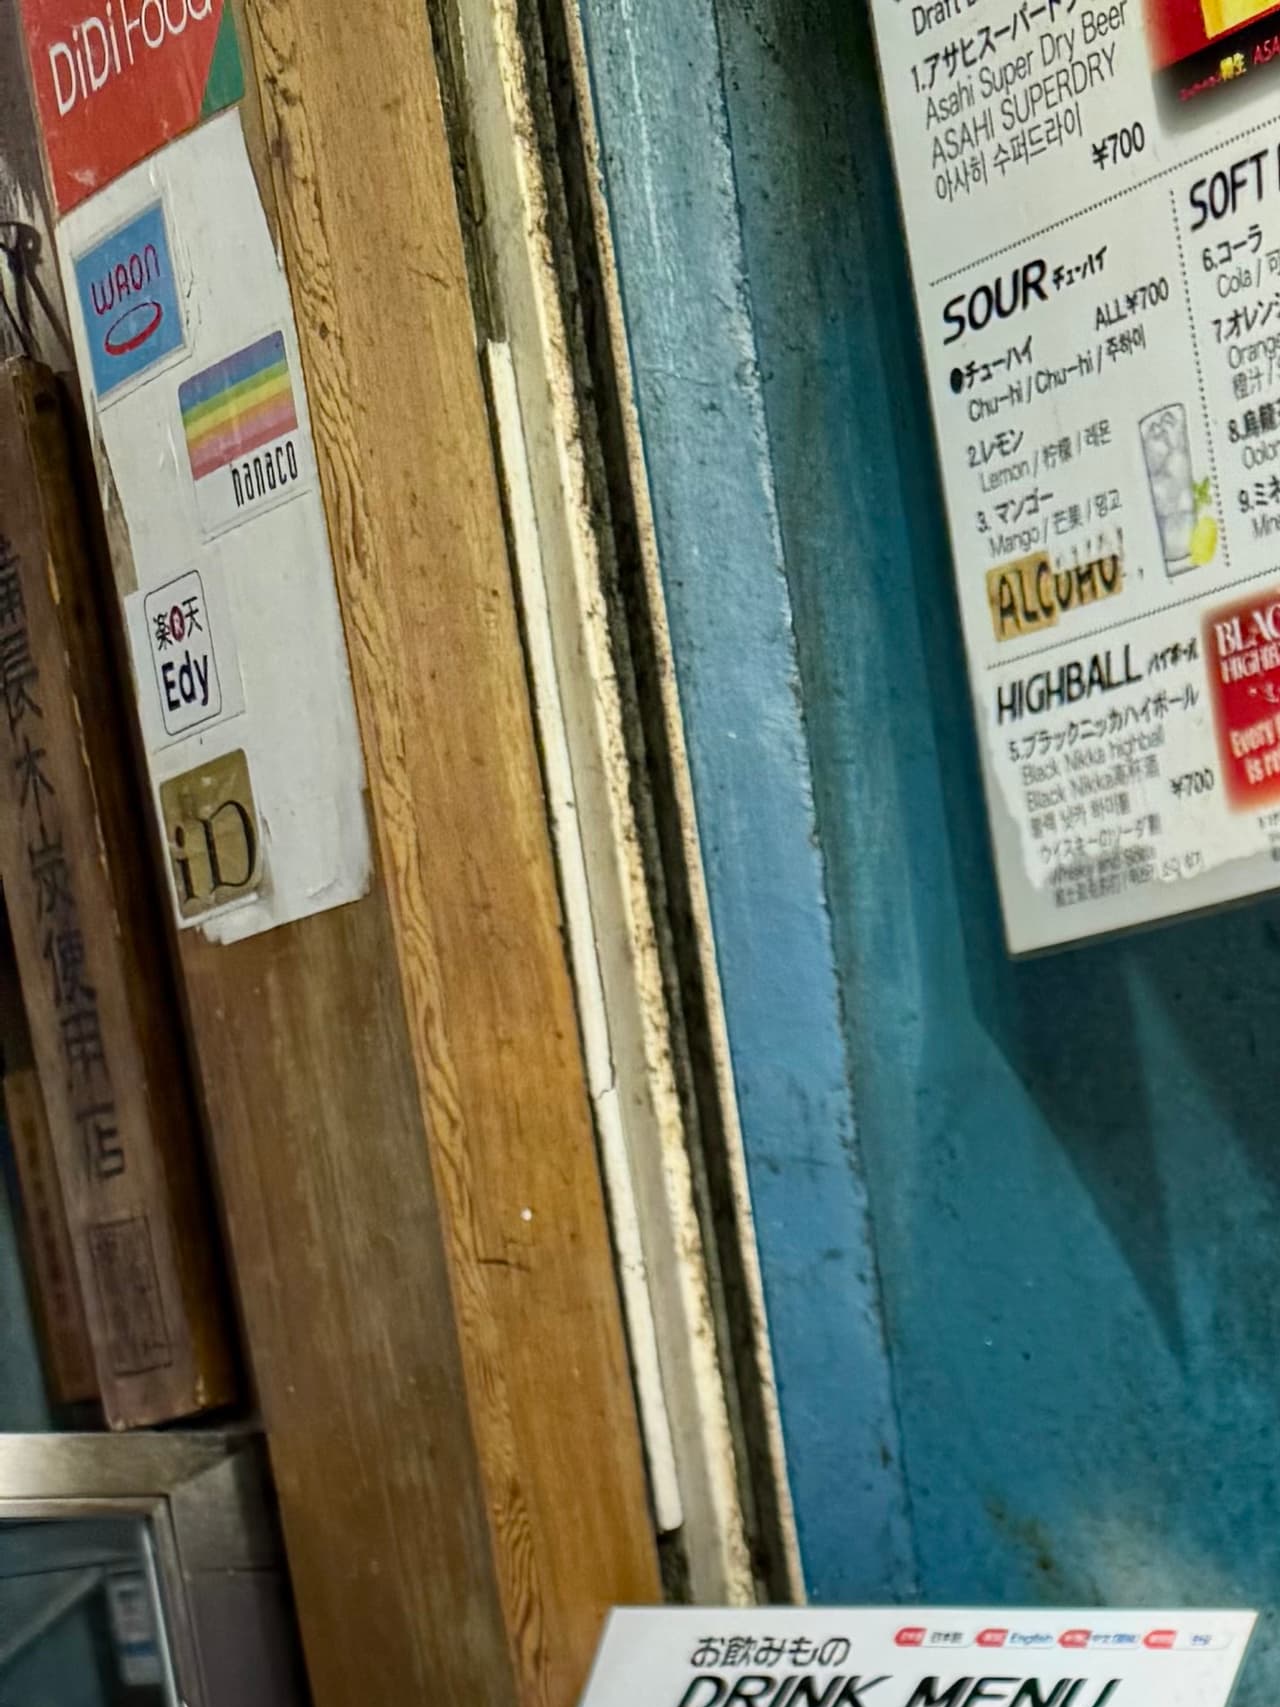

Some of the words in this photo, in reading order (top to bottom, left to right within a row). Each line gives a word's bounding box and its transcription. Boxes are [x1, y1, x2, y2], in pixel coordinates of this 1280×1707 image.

[50, 1, 121, 117] DiDi
[925, 75, 975, 131] Asahi
[979, 48, 1034, 103] Super
[1040, 22, 1075, 68] Dry
[1082, 0, 1128, 45] Beer
[932, 106, 995, 170] ASAHI
[1001, 41, 1117, 131] SUPERDRY
[935, 156, 988, 203] 아사히
[992, 102, 1083, 177] 수퍼드라이
[1091, 121, 1146, 170] ¥700
[1189, 148, 1269, 231] SOFT
[1201, 223, 1264, 273] 6.コーラ
[91, 243, 160, 316] WAON
[943, 258, 1049, 346] SOUR
[1051, 246, 1109, 291] チューハイ
[1095, 277, 1170, 331] ALL¥700
[1217, 266, 1253, 298] Cola
[965, 335, 1033, 389] チューハイ
[968, 380, 1024, 422] Chu-hi
[1034, 349, 1094, 395] Chu-hi
[230, 440, 298, 507] hanaco
[979, 460, 1031, 493] Lemon
[994, 487, 1055, 525] マンゴー
[988, 524, 1041, 558] Mango
[161, 650, 209, 712] Edy
[995, 642, 1143, 725] HIGHBALL
[1169, 767, 1215, 799] ¥700
[1244, 756, 1263, 785] is
[174, 799, 257, 901] iD
[690, 1635, 852, 1668] お飲みもの
[1009, 1632, 1054, 1647] English
